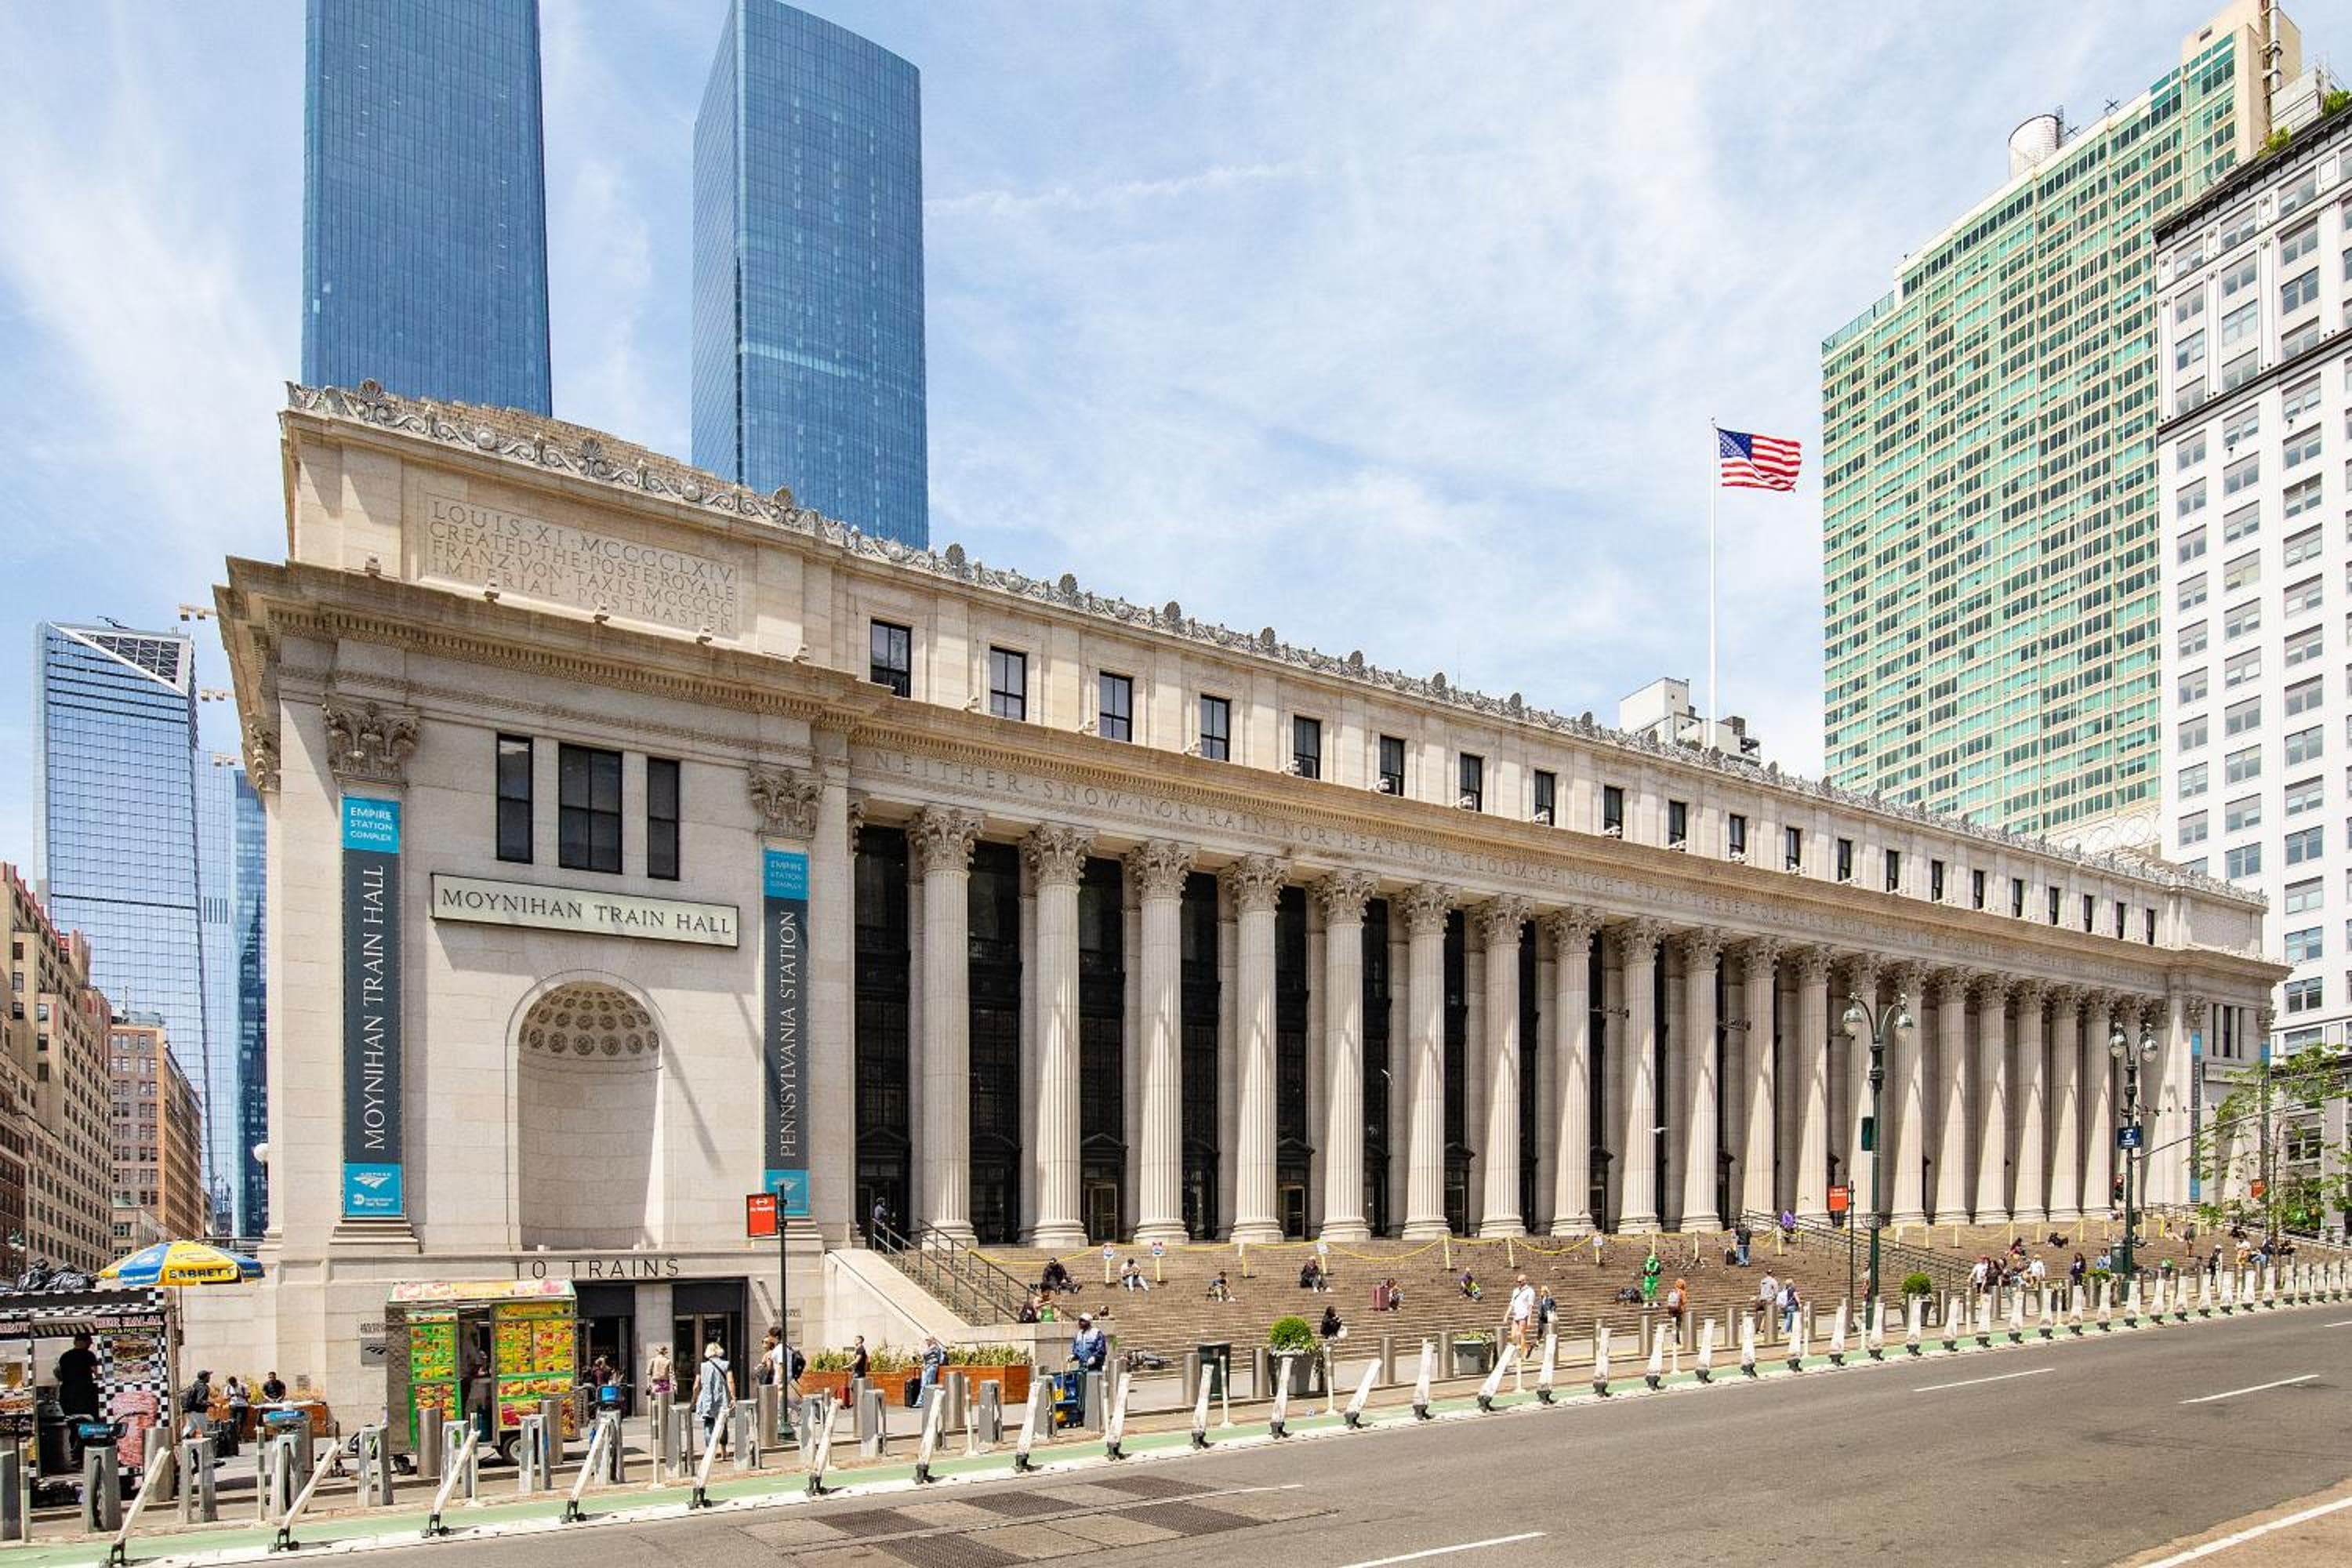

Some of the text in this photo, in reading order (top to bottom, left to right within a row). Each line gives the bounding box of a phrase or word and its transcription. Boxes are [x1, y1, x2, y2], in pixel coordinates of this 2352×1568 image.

[430, 521, 734, 602] CREATED THE POSTE ROYALE
[432, 539, 733, 618] FRANZ VON TAXIS MCCCCC
[433, 501, 732, 583] LOUIS XI MCCCCLXIV
[433, 557, 731, 633] IMPERIAL POSTMASTER
[350, 807, 392, 821] EMPIRE
[350, 819, 392, 831] STATION
[350, 830, 391, 841] COMPLEX
[874, 751, 1024, 793] NEITHER
[1043, 780, 1121, 809] SNOW
[1138, 798, 1192, 822] NOR
[1207, 808, 1267, 834] RAIN
[1283, 822, 1330, 845] NOR
[1341, 833, 1396, 857] HEAT
[1408, 843, 1450, 866] NOR
[1462, 853, 1526, 878] GLOOM
[1537, 864, 1558, 881] OF
[1568, 870, 1627, 894] NIGHT
[363, 865, 383, 924] HALL
[441, 887, 731, 935] MOYNIHAN TRAIN HALL
[363, 932, 383, 1007] TRAIN
[780, 911, 796, 1157] PENNSYLVANIA STATION
[363, 1015, 385, 1150] MOYNIHAN
[567, 1258, 679, 1279] TRAINS
